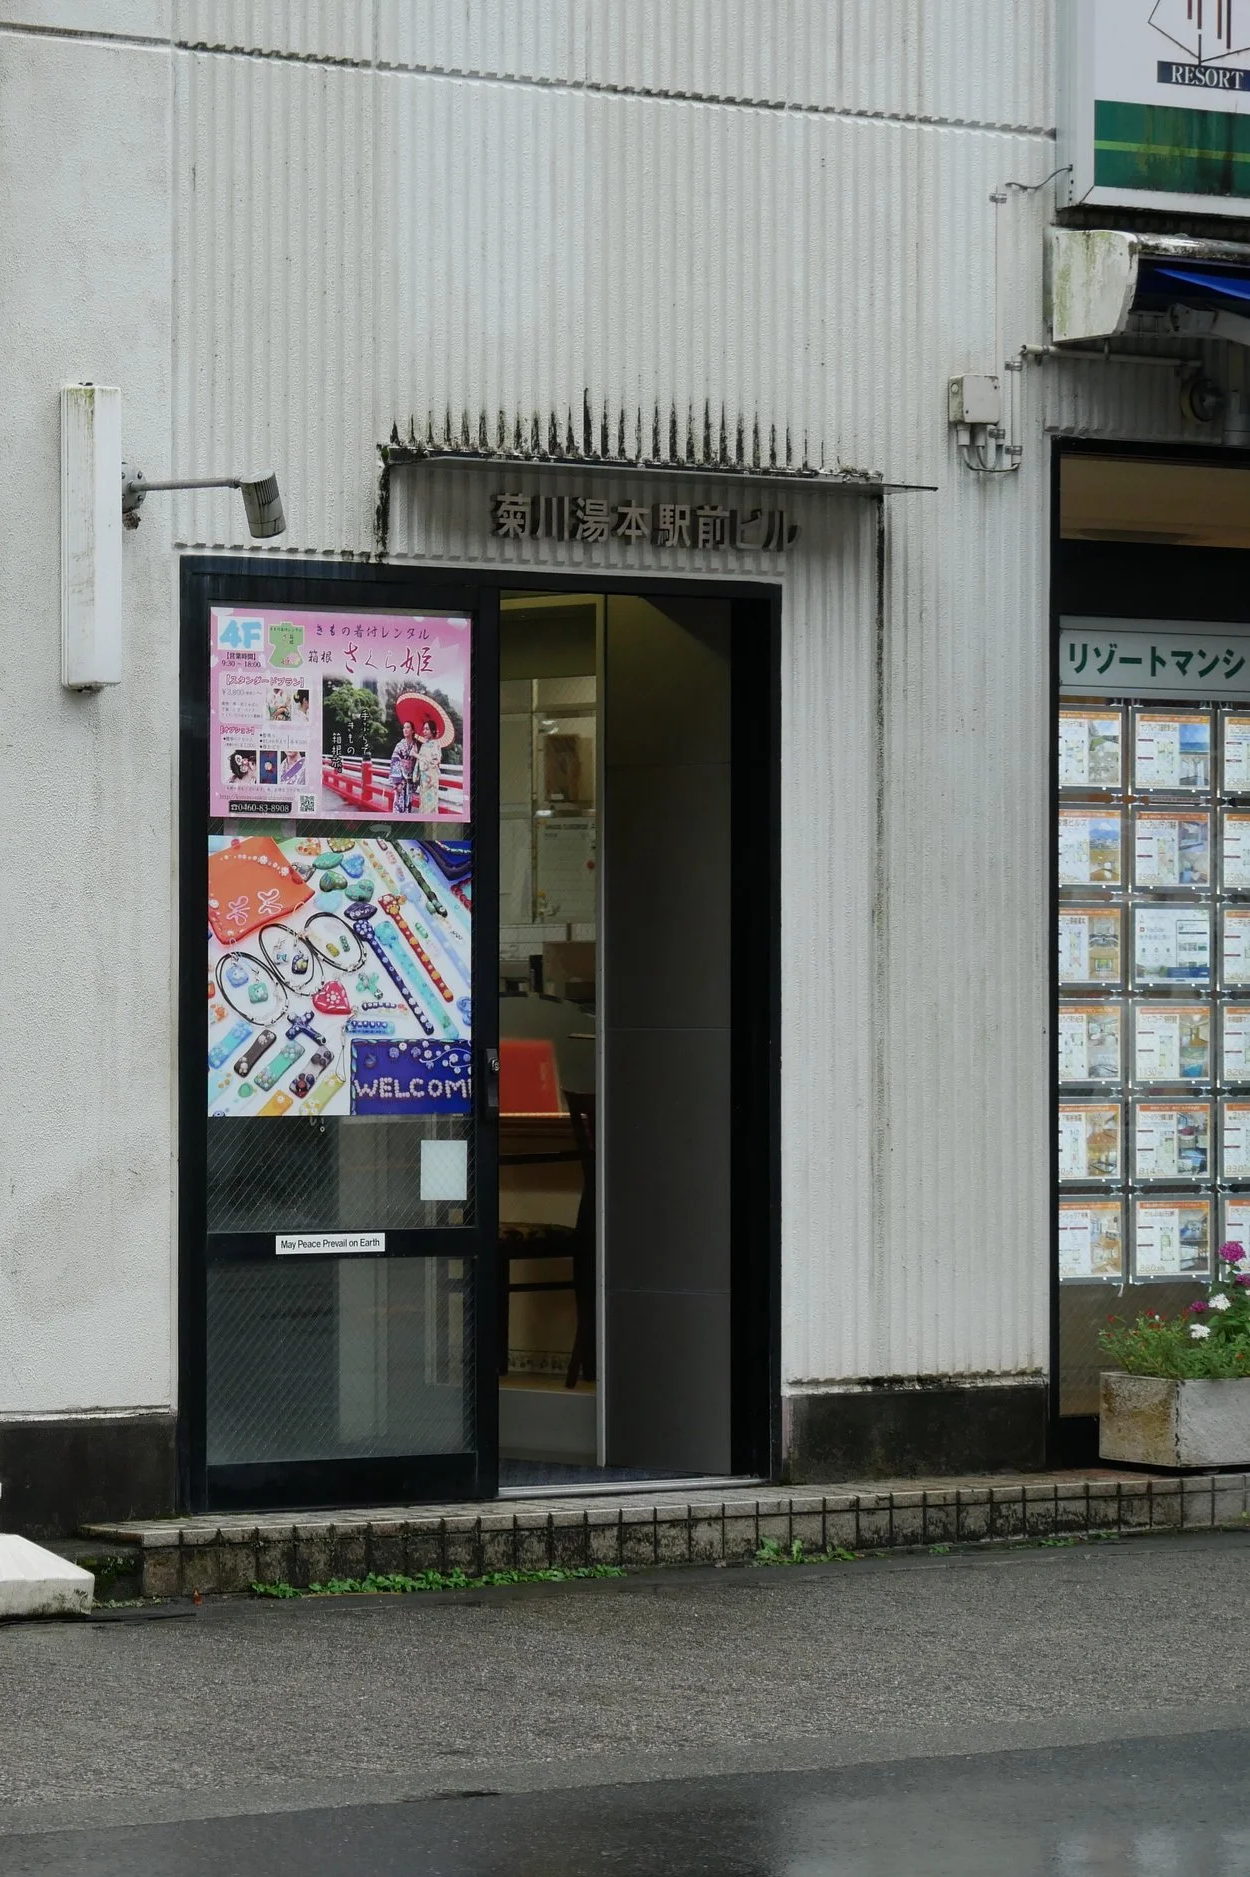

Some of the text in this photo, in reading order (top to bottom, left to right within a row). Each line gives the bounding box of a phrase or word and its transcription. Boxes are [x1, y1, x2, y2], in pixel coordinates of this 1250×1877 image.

[1171, 65, 1244, 89] RESORT
[497, 493, 799, 549] 菊川湯本駅前ビル
[219, 619, 262, 649] 4F
[316, 624, 430, 640] きもの着付レンタル
[308, 642, 434, 676] 箱根 さくら姫
[1069, 643, 1246, 680] リゾートマンシ
[238, 804, 290, 812] 0460-83-8908
[355, 1077, 471, 1098] WELCOM
[281, 1240, 296, 1250] May
[297, 1239, 321, 1248] Peace
[323, 1239, 348, 1248] Prevail
[360, 1238, 380, 1247] Earth
